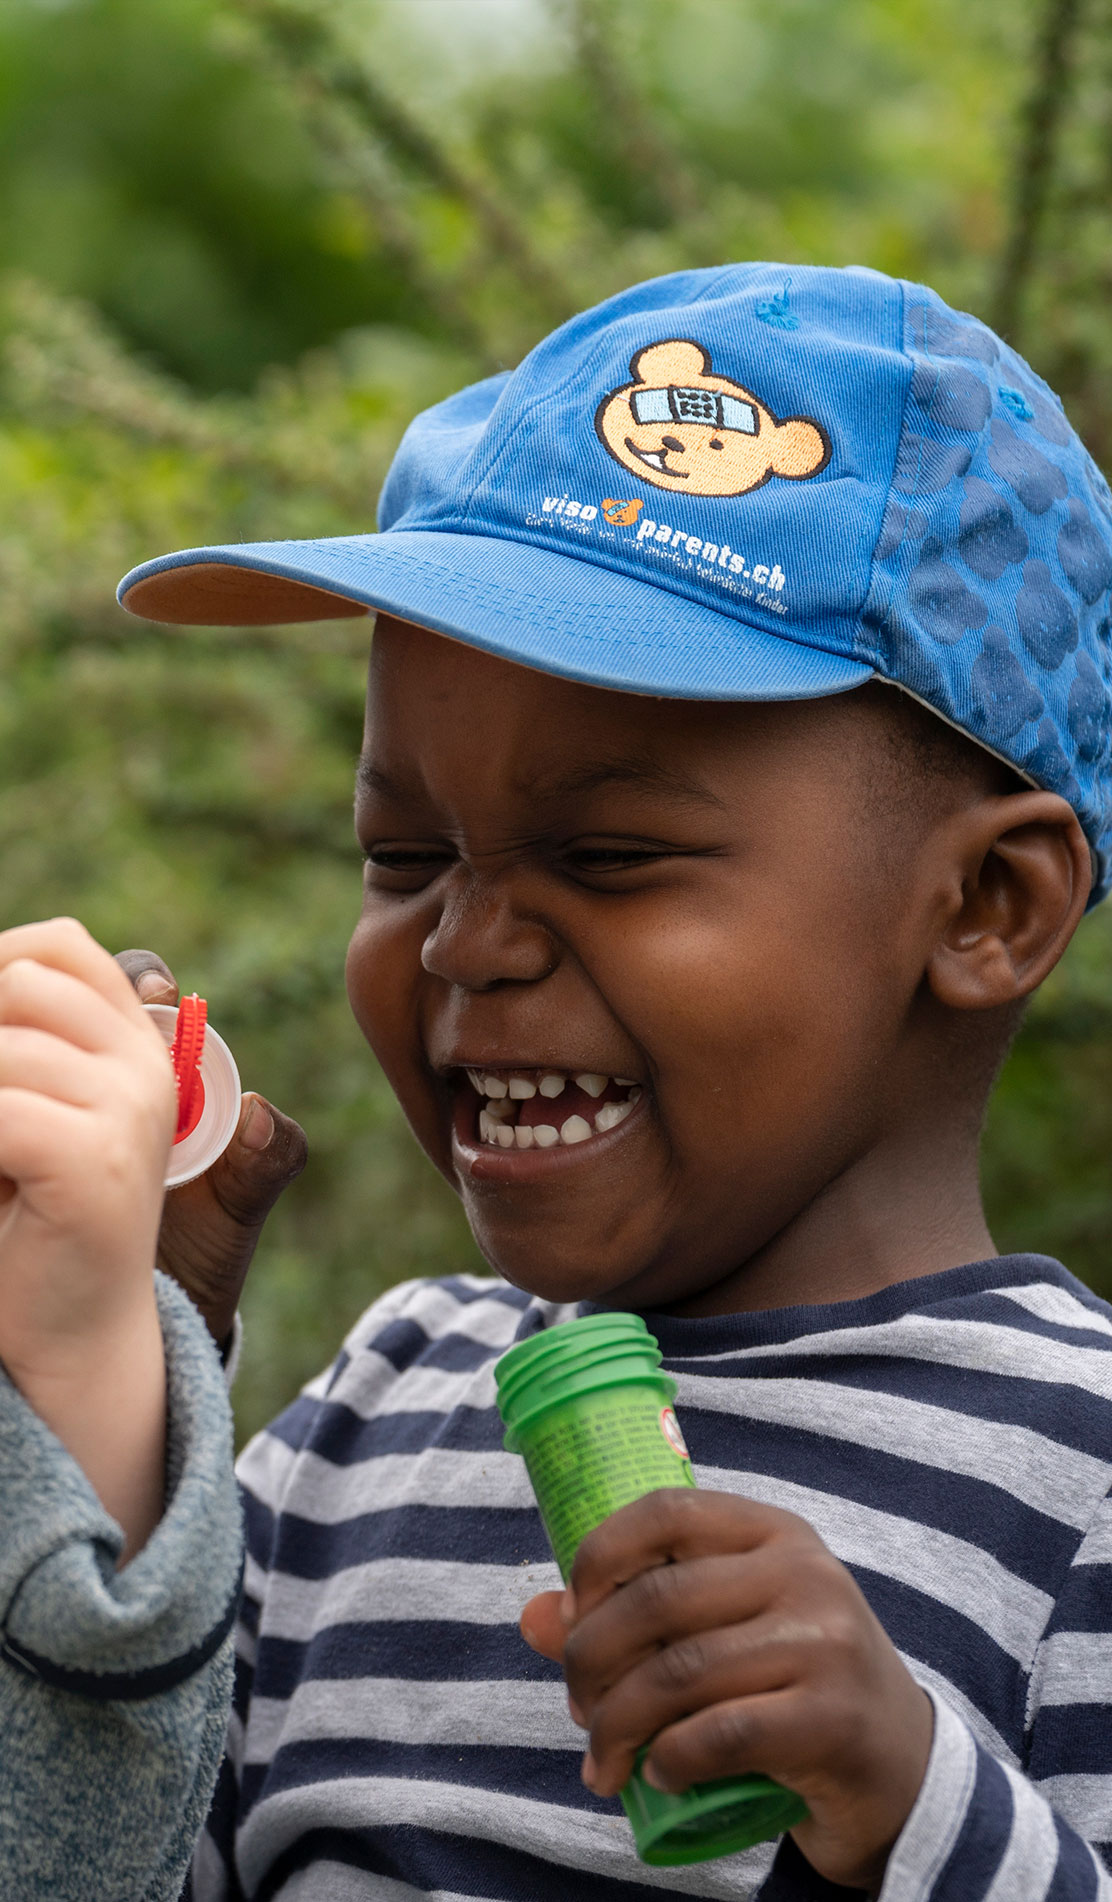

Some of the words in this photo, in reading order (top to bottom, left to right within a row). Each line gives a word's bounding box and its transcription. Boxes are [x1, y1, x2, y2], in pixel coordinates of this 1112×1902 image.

[542, 493, 598, 521] viso
[636, 518, 786, 591] parents.ch
[755, 592, 788, 615] Kinder
